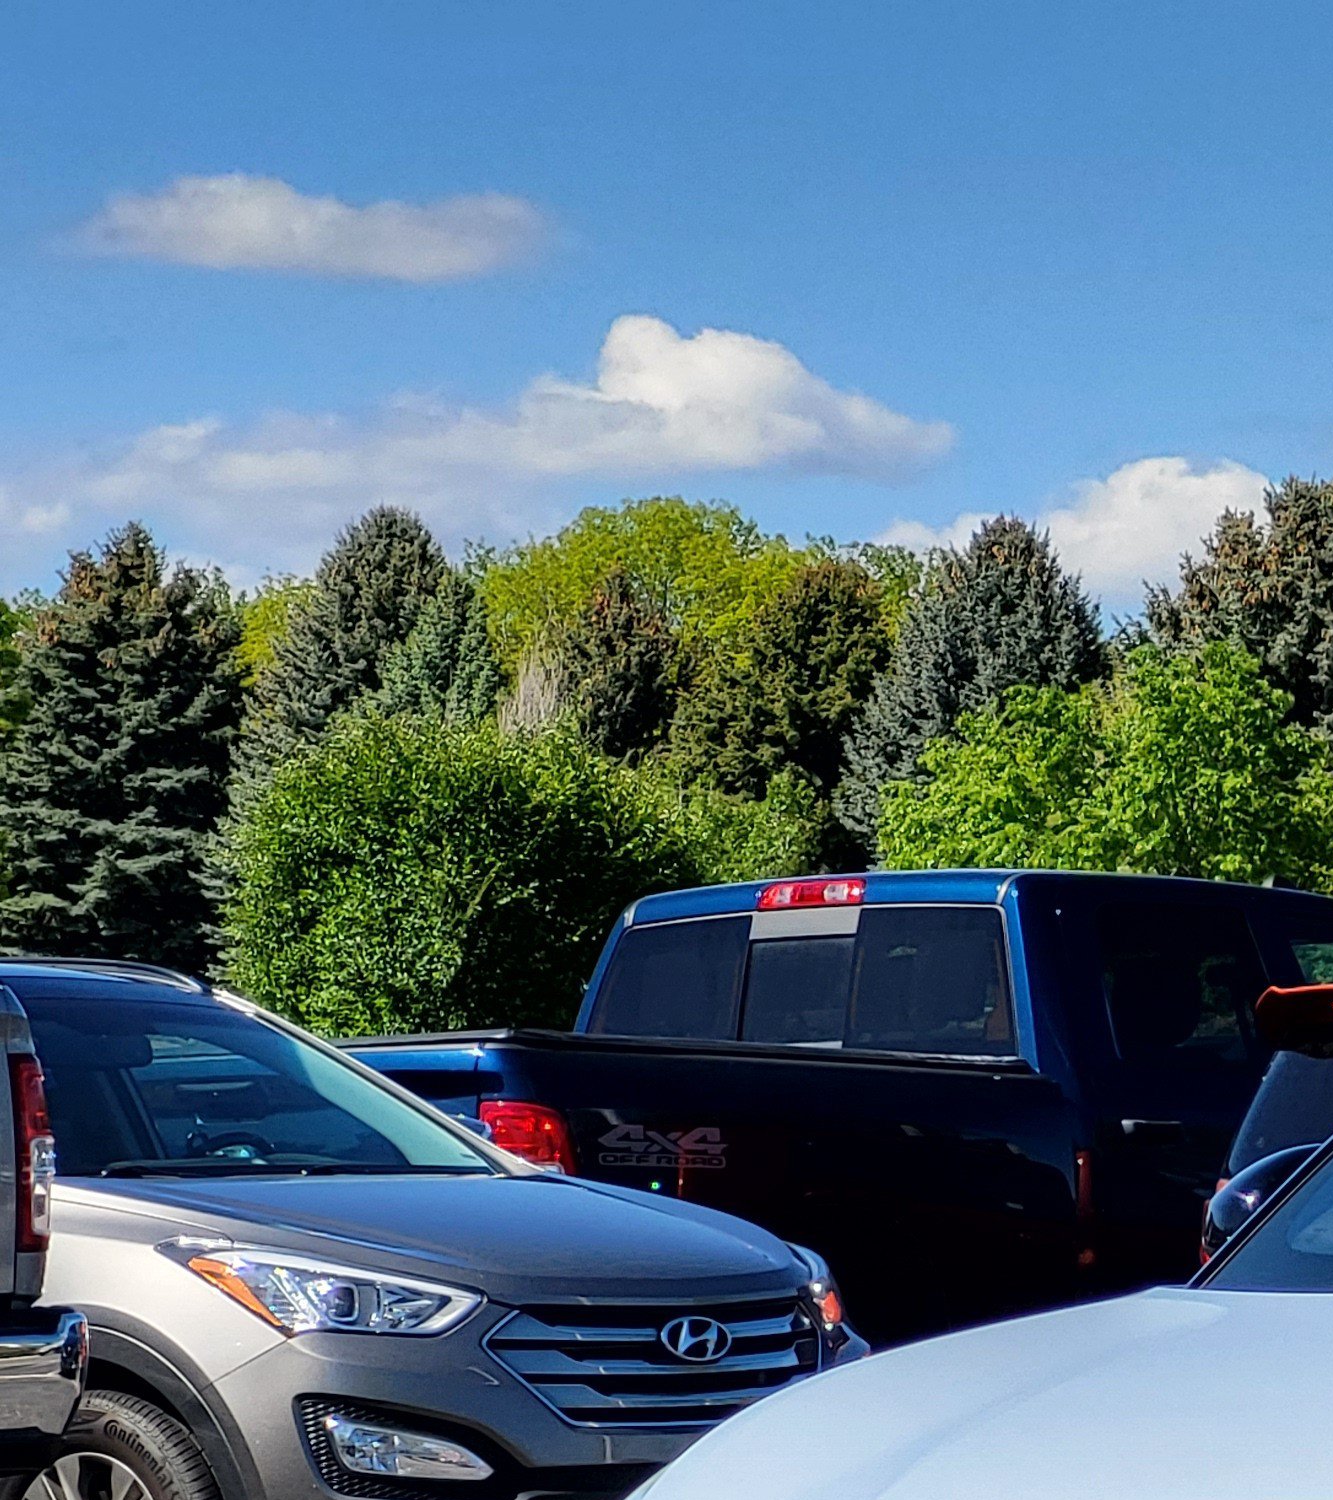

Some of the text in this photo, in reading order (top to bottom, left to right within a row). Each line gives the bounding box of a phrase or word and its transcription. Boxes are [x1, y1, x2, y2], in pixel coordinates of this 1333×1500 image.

[601, 1155, 724, 1168] OFF ROAD
[104, 1420, 174, 1490] Continental
